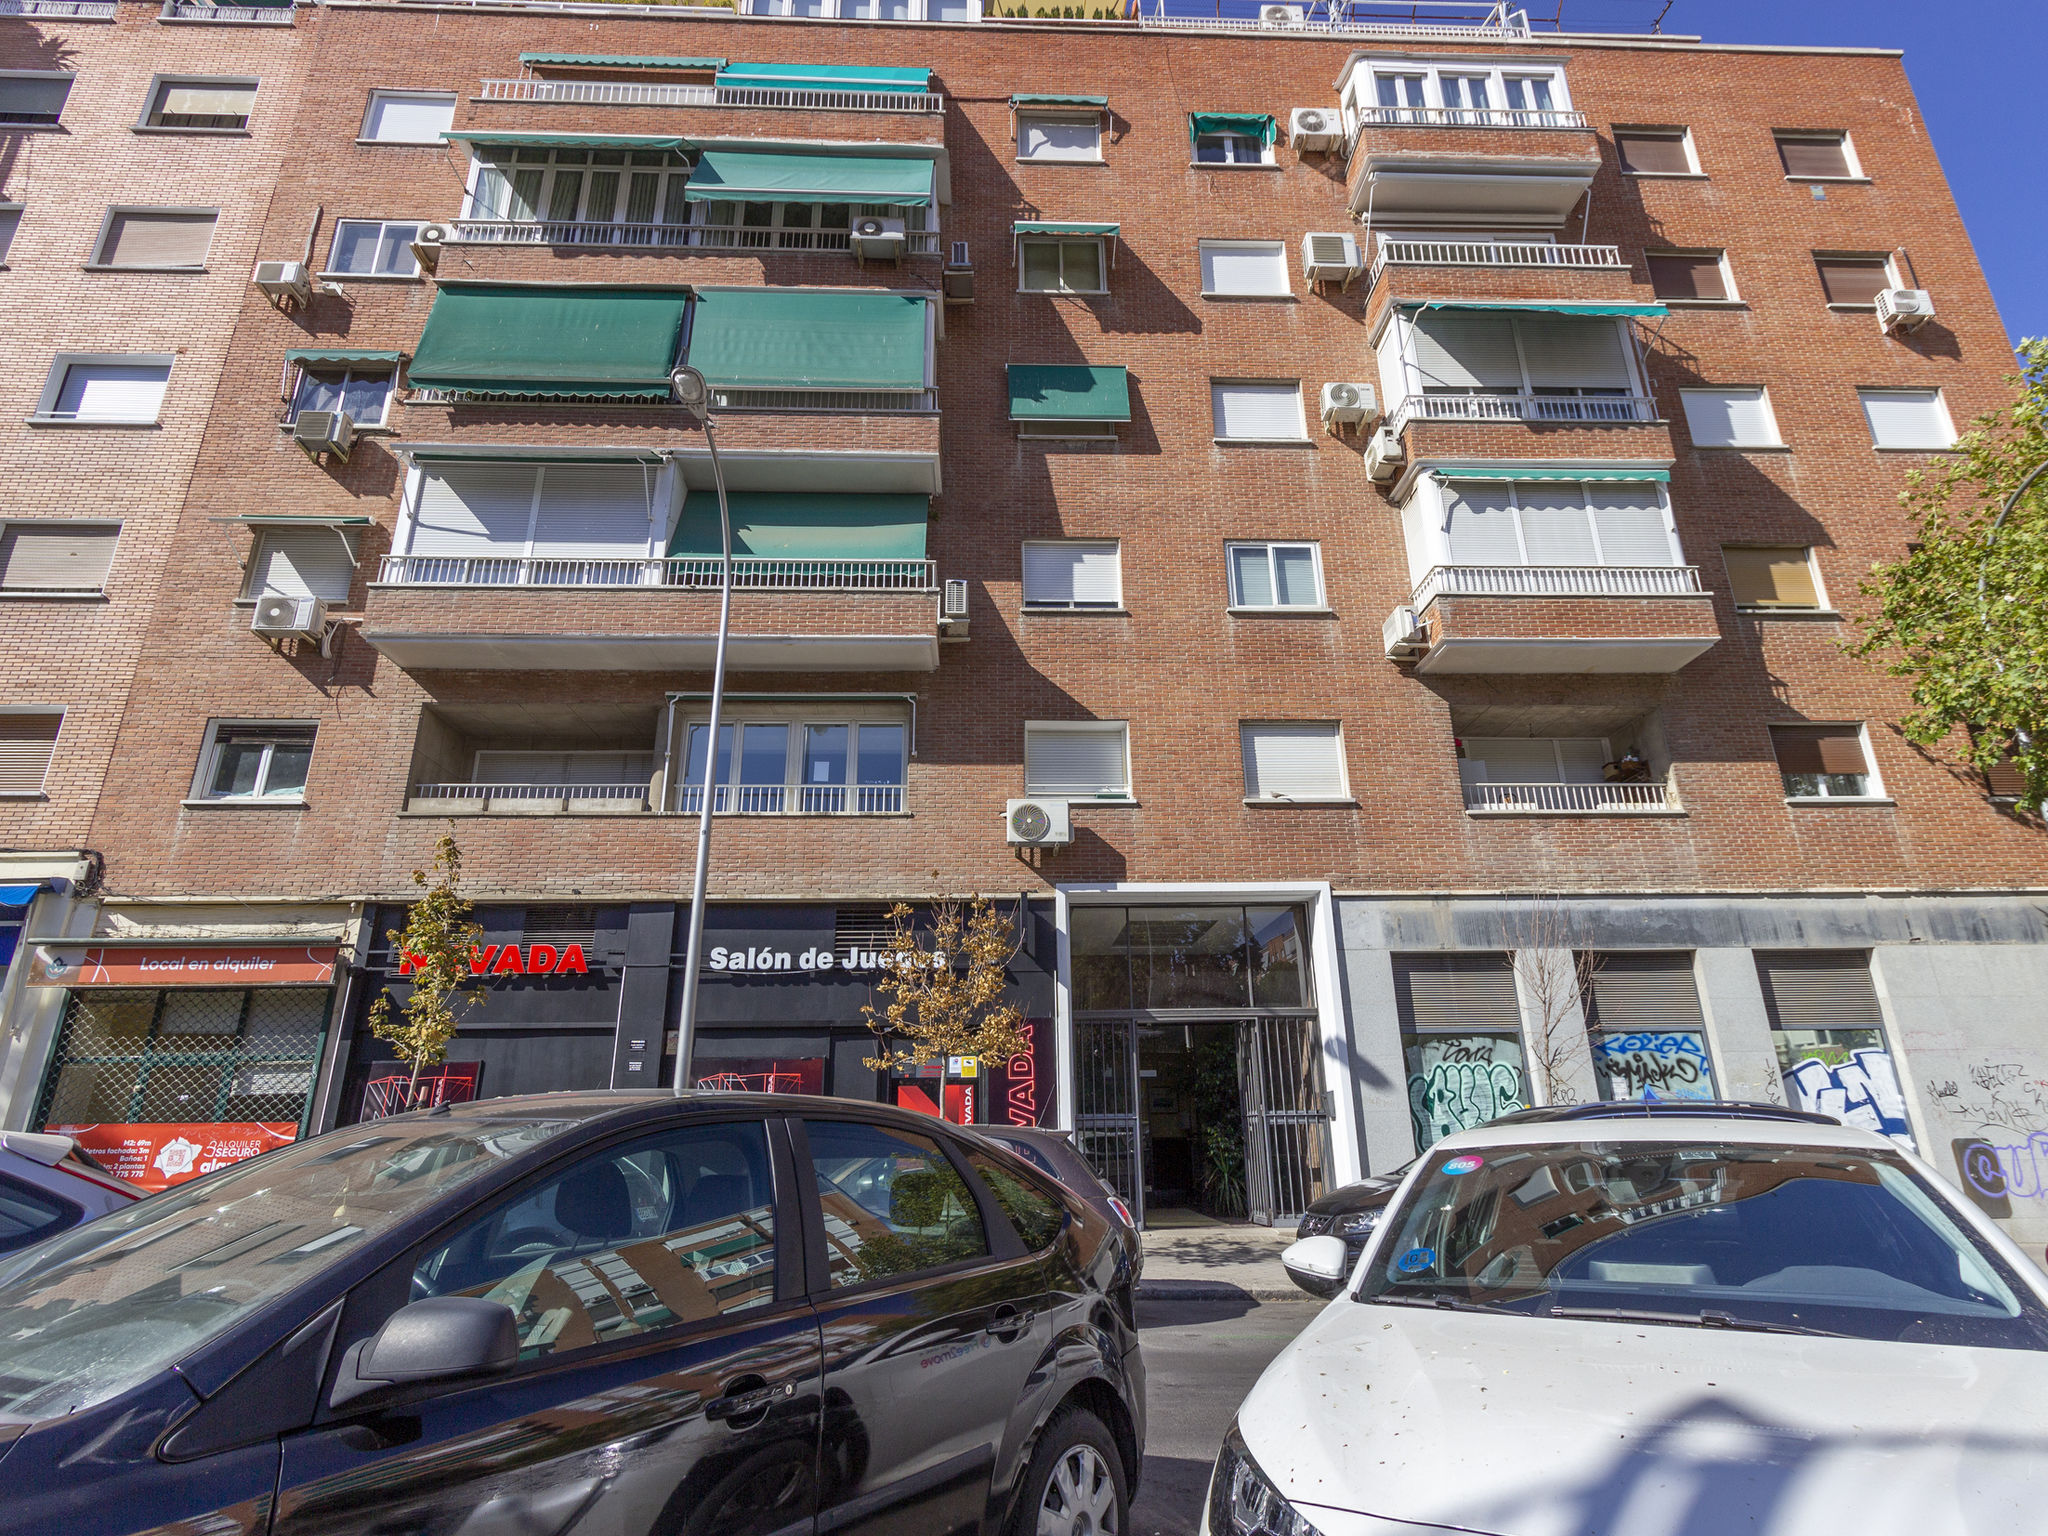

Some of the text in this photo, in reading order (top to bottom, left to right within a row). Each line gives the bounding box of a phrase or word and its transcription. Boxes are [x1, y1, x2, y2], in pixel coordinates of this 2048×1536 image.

[399, 943, 589, 975] NVADA
[709, 946, 791, 970] Salón
[799, 947, 834, 970] de
[140, 956, 276, 973] Local en alquiler
[216, 1140, 262, 1148] ALQUILER
[215, 1147, 260, 1158] SEGURO
[119, 1163, 146, 1171] plantas
[115, 1170, 129, 1178] 775
[130, 1170, 145, 1178] 775
